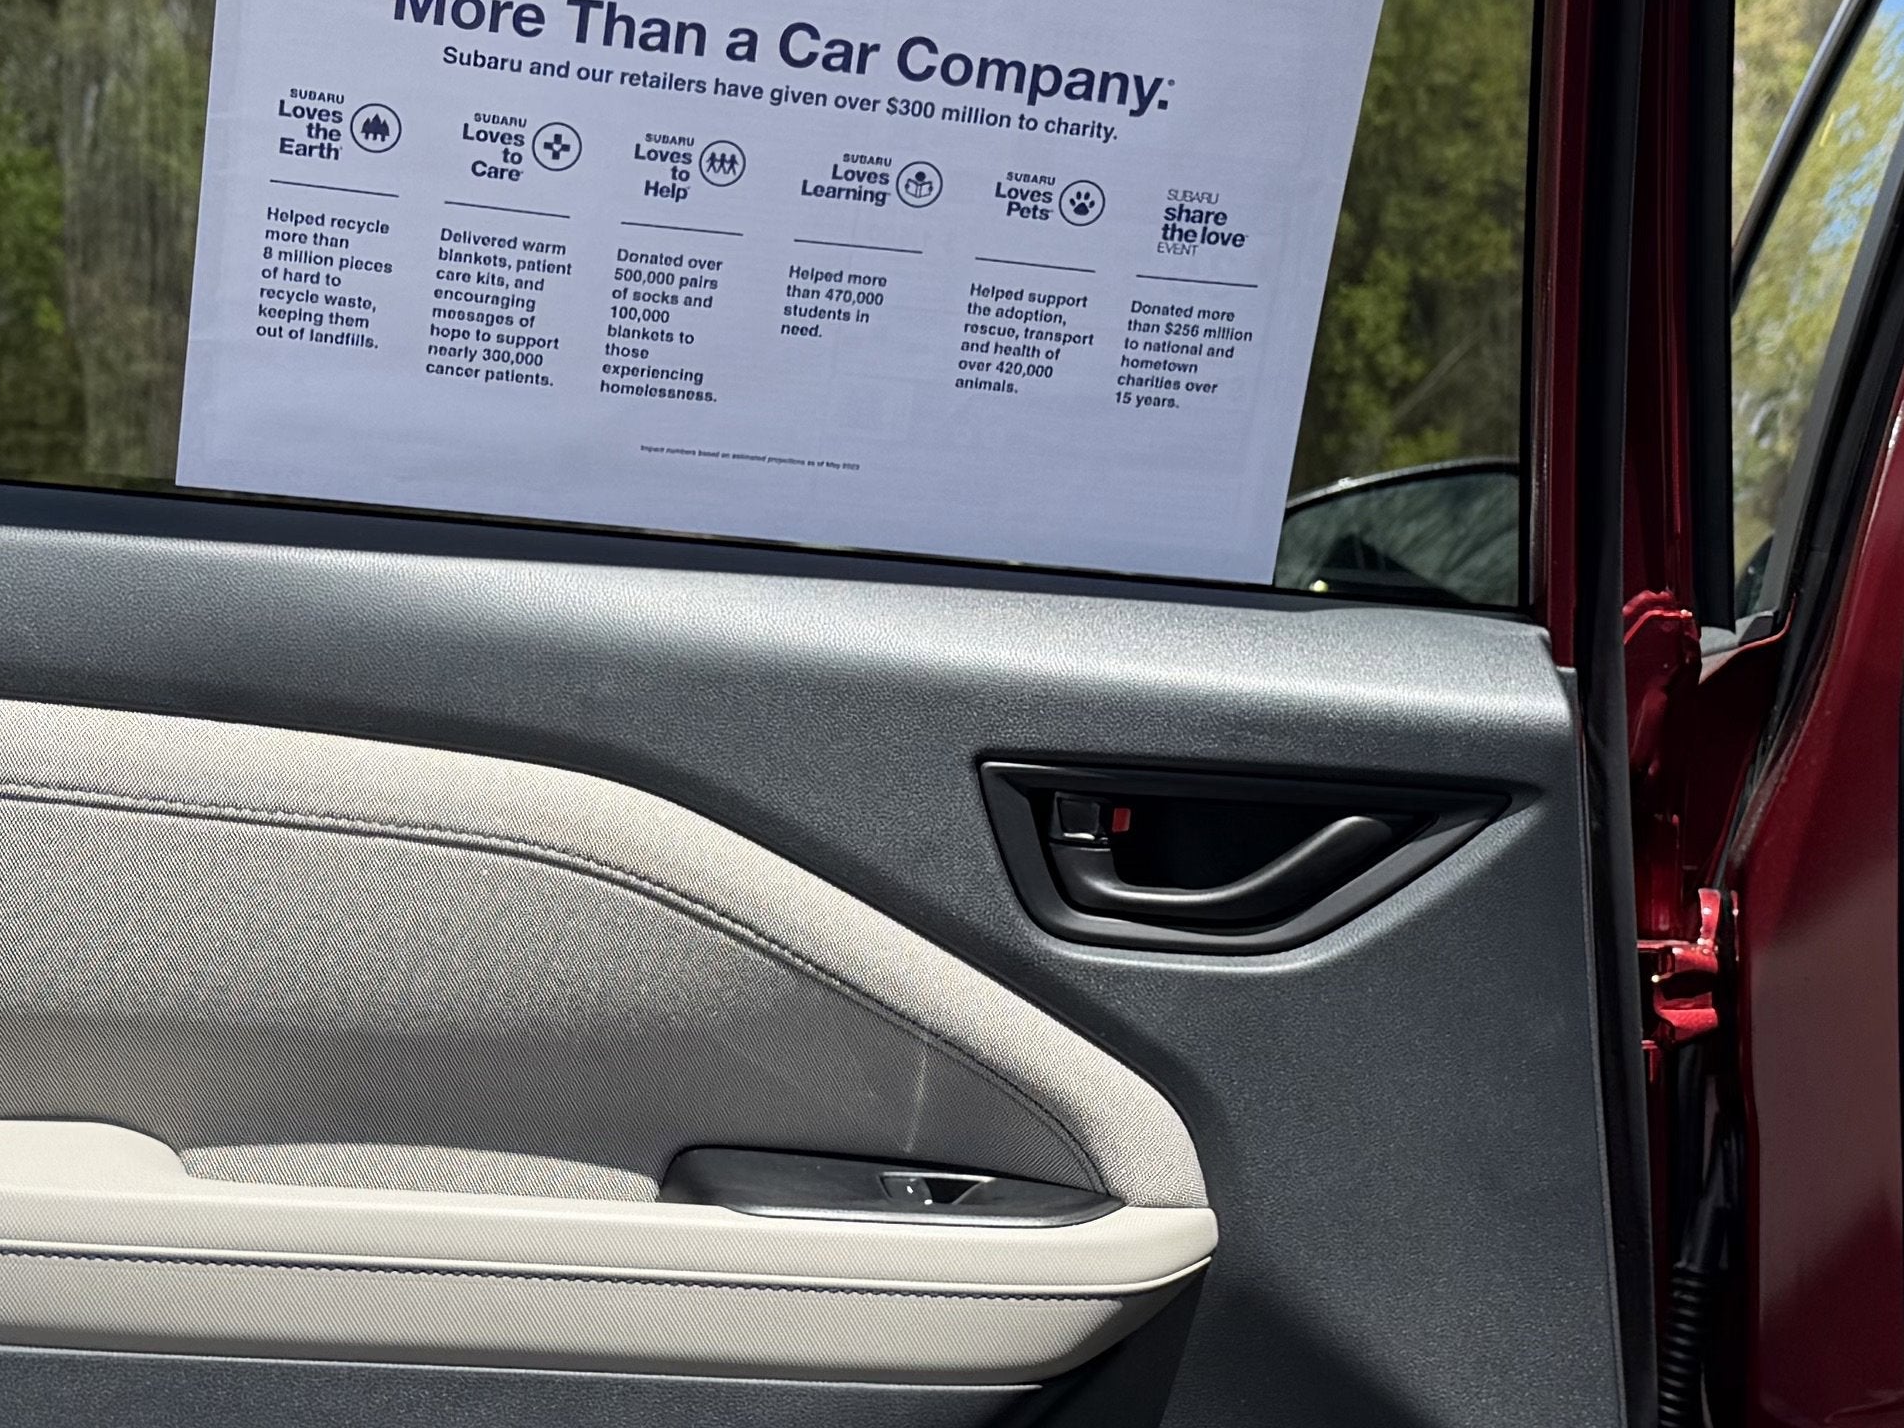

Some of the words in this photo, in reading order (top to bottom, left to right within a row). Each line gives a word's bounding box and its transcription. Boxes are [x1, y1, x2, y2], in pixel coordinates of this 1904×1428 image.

[725, 27, 758, 63] a
[778, 21, 881, 75] Car
[289, 87, 345, 105] SUBARU
[442, 45, 522, 73] Subaru
[528, 60, 571, 79] and
[576, 66, 614, 83] our
[619, 70, 707, 94] retailers
[713, 77, 764, 100] have
[769, 84, 828, 107] given
[833, 94, 881, 112] over
[885, 96, 936, 119] $300
[940, 105, 1012, 129] million
[1017, 112, 1039, 131] to
[1043, 116, 1118, 144] charity.
[278, 98, 344, 124] Loves
[473, 112, 527, 129] SUBARU
[305, 122, 342, 142] the
[462, 122, 525, 147] Loves
[644, 132, 695, 147] SUBARU
[278, 136, 341, 161] Earth
[501, 147, 523, 165] to
[633, 142, 693, 165] Loves
[842, 152, 892, 167] SUBARU
[470, 159, 524, 182] Care
[669, 164, 691, 182] to
[831, 163, 890, 186] Loves
[1005, 170, 1056, 186] SUBARU
[643, 179, 691, 203] Help
[800, 178, 890, 207] Learning
[994, 180, 1054, 204] Loves
[1166, 188, 1220, 205] SUBARU
[266, 206, 326, 227] Helped
[330, 217, 390, 234] recycle
[1005, 200, 1054, 221] Pets
[1163, 202, 1228, 227] share
[264, 228, 308, 245] more
[312, 232, 349, 250] than
[440, 227, 518, 250] Delivered
[522, 240, 566, 256] warm
[1160, 221, 1198, 244] the
[1199, 225, 1249, 248] love
[262, 245, 273, 260] 8
[277, 248, 334, 267] million
[338, 255, 393, 274] pieces
[616, 247, 684, 268] Donated
[687, 257, 724, 271] over
[1156, 241, 1199, 257] EVENT
[437, 246, 512, 271] blankets,
[515, 258, 572, 276] patient
[261, 265, 279, 280] of
[282, 267, 321, 285] hard
[324, 272, 342, 287] to
[435, 269, 471, 283] care
[475, 270, 509, 290] kits,
[513, 277, 545, 292] and
[613, 267, 675, 286] 500,000
[678, 274, 718, 290] pairs
[788, 264, 844, 284] Helped
[847, 273, 887, 288] more
[259, 287, 319, 305] recycle
[323, 293, 376, 313] waste,
[433, 287, 536, 313] encouraging
[611, 286, 629, 300] of
[632, 289, 679, 305] socks
[682, 295, 713, 308] and
[786, 284, 821, 300] than
[824, 287, 884, 306] 470,000
[969, 282, 1024, 302] Helped
[1027, 292, 1088, 309] support
[258, 302, 324, 327] keeping
[328, 311, 370, 329] them
[431, 307, 514, 327] messages
[518, 315, 536, 329] of
[610, 305, 670, 324] 100,000
[783, 303, 851, 322] students
[855, 308, 870, 324] in
[966, 301, 992, 317] the
[994, 305, 1067, 328] adoption,
[1130, 299, 1194, 319] Donated
[1196, 309, 1235, 322] more
[255, 325, 283, 339] out
[287, 326, 305, 341] of
[308, 328, 378, 349] landfills.
[429, 322, 471, 342] hope
[475, 328, 491, 342] to
[496, 333, 559, 350] support
[606, 323, 674, 343] blankets
[678, 331, 695, 345] to
[780, 323, 822, 338] need.
[963, 322, 1020, 341] rescue,
[1023, 326, 1094, 346] transport
[1127, 318, 1160, 334] than
[1164, 321, 1200, 338] $256
[1202, 325, 1253, 342] million
[427, 344, 478, 363] nearly
[482, 347, 543, 367] 300,000
[604, 342, 649, 360] those
[960, 340, 991, 354] and
[993, 340, 1041, 359] health
[1044, 347, 1061, 361] of
[1123, 336, 1139, 350] to
[1142, 339, 1203, 356] national
[1206, 345, 1235, 359] and
[425, 363, 481, 378] cancer
[484, 368, 554, 387] patients.
[601, 363, 704, 386] experiencing
[957, 359, 992, 372] over
[995, 360, 1054, 379] 420,000
[1120, 353, 1198, 374] hometown
[599, 379, 717, 403] homelessness.
[954, 376, 1018, 394] animals.
[1116, 373, 1181, 391] charities
[1184, 381, 1219, 394] over
[1115, 390, 1132, 405] 15
[1134, 394, 1180, 409] years.
